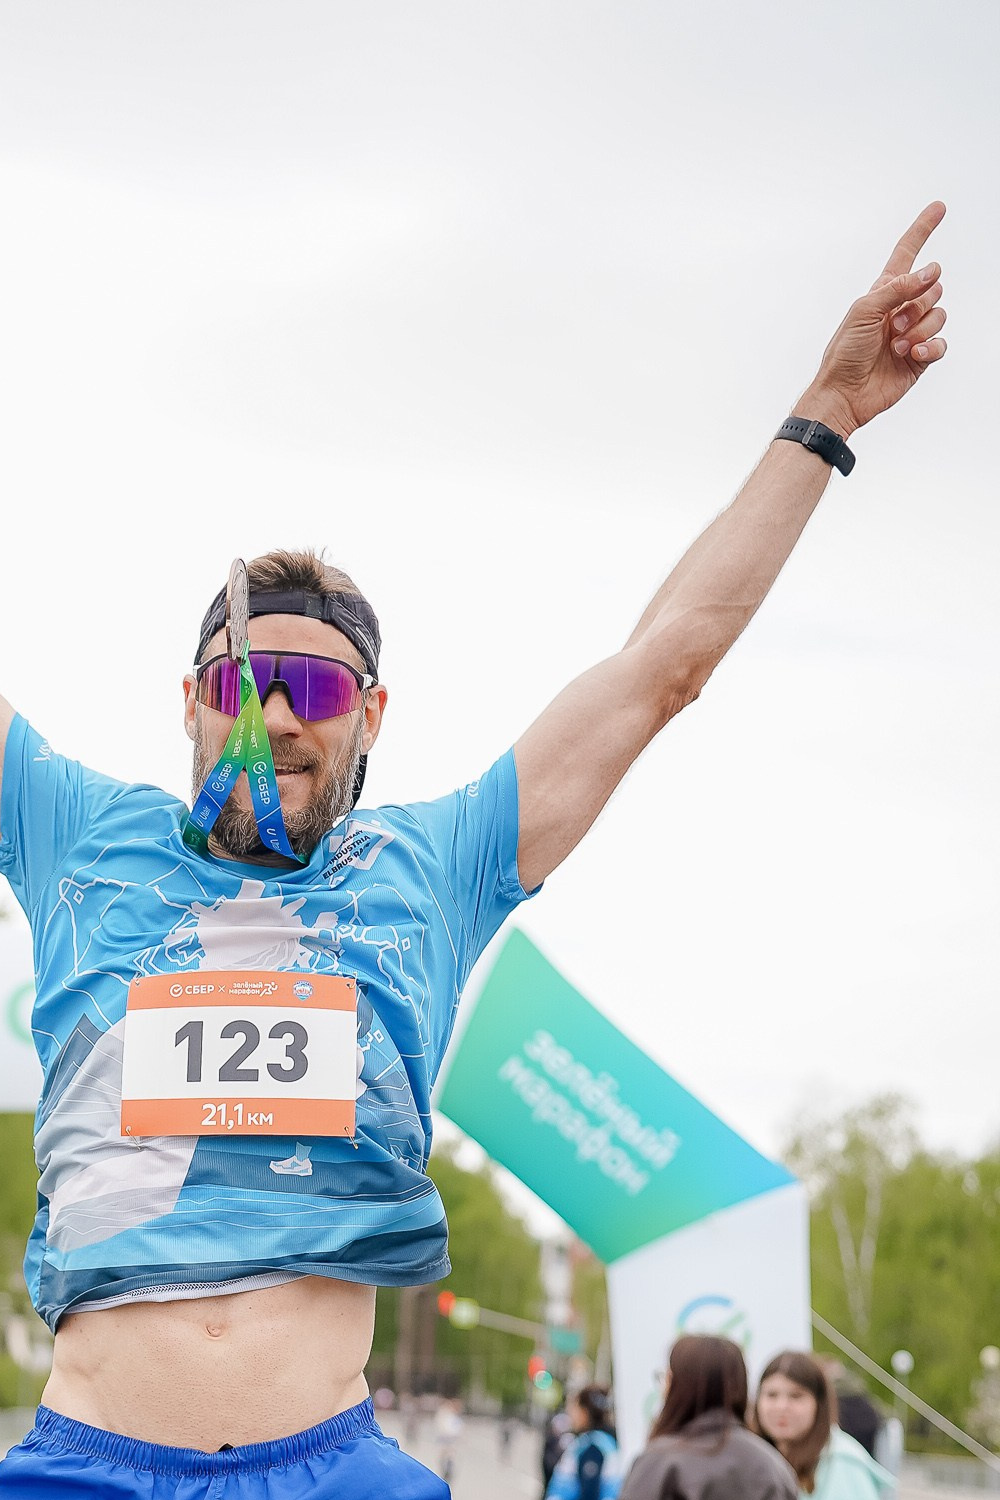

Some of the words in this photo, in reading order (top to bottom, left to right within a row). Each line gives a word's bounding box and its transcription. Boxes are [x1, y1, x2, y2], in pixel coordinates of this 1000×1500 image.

[232, 739, 242, 758] 185
[218, 763, 233, 782] СБЕР
[257, 776, 271, 805] СБЕР
[328, 835, 371, 865] INDUSTRIA
[322, 855, 353, 880] ELBRUS
[185, 984, 215, 995] СБЕР
[228, 988, 260, 996] марафон
[233, 981, 263, 989] зелёный
[174, 1020, 309, 1083] 123
[201, 1103, 244, 1130] 21,1
[499, 1057, 648, 1195] марафон
